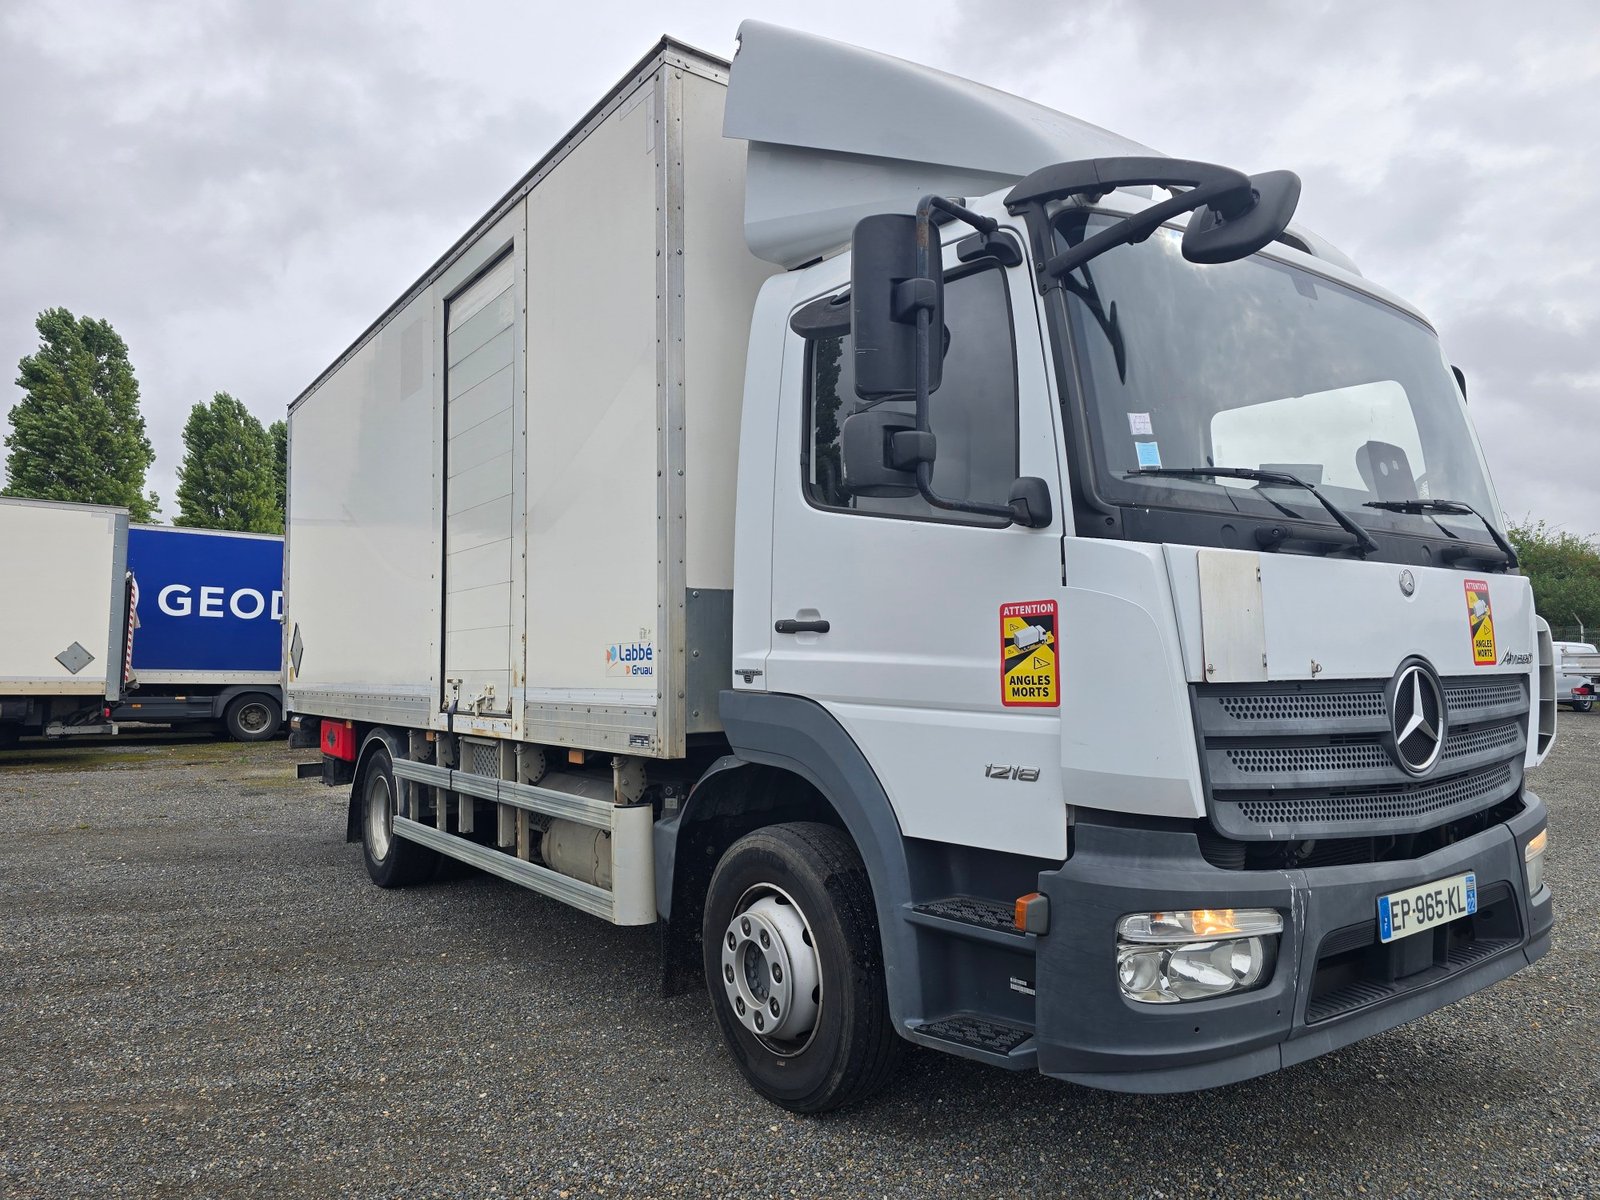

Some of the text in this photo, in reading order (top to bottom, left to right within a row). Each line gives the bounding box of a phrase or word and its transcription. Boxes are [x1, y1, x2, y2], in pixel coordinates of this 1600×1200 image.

[1466, 582, 1487, 591] ATTENTION
[1003, 603, 1054, 616] ATTENTION
[1476, 639, 1492, 648] ANGLES
[619, 643, 653, 661] Labbé
[1478, 649, 1492, 657] MORTS
[632, 665, 652, 675] Gruau
[1009, 675, 1051, 686] ANGLES
[1012, 687, 1049, 697] MORTS
[984, 763, 1041, 782] 1218
[1467, 898, 1475, 912] 22
